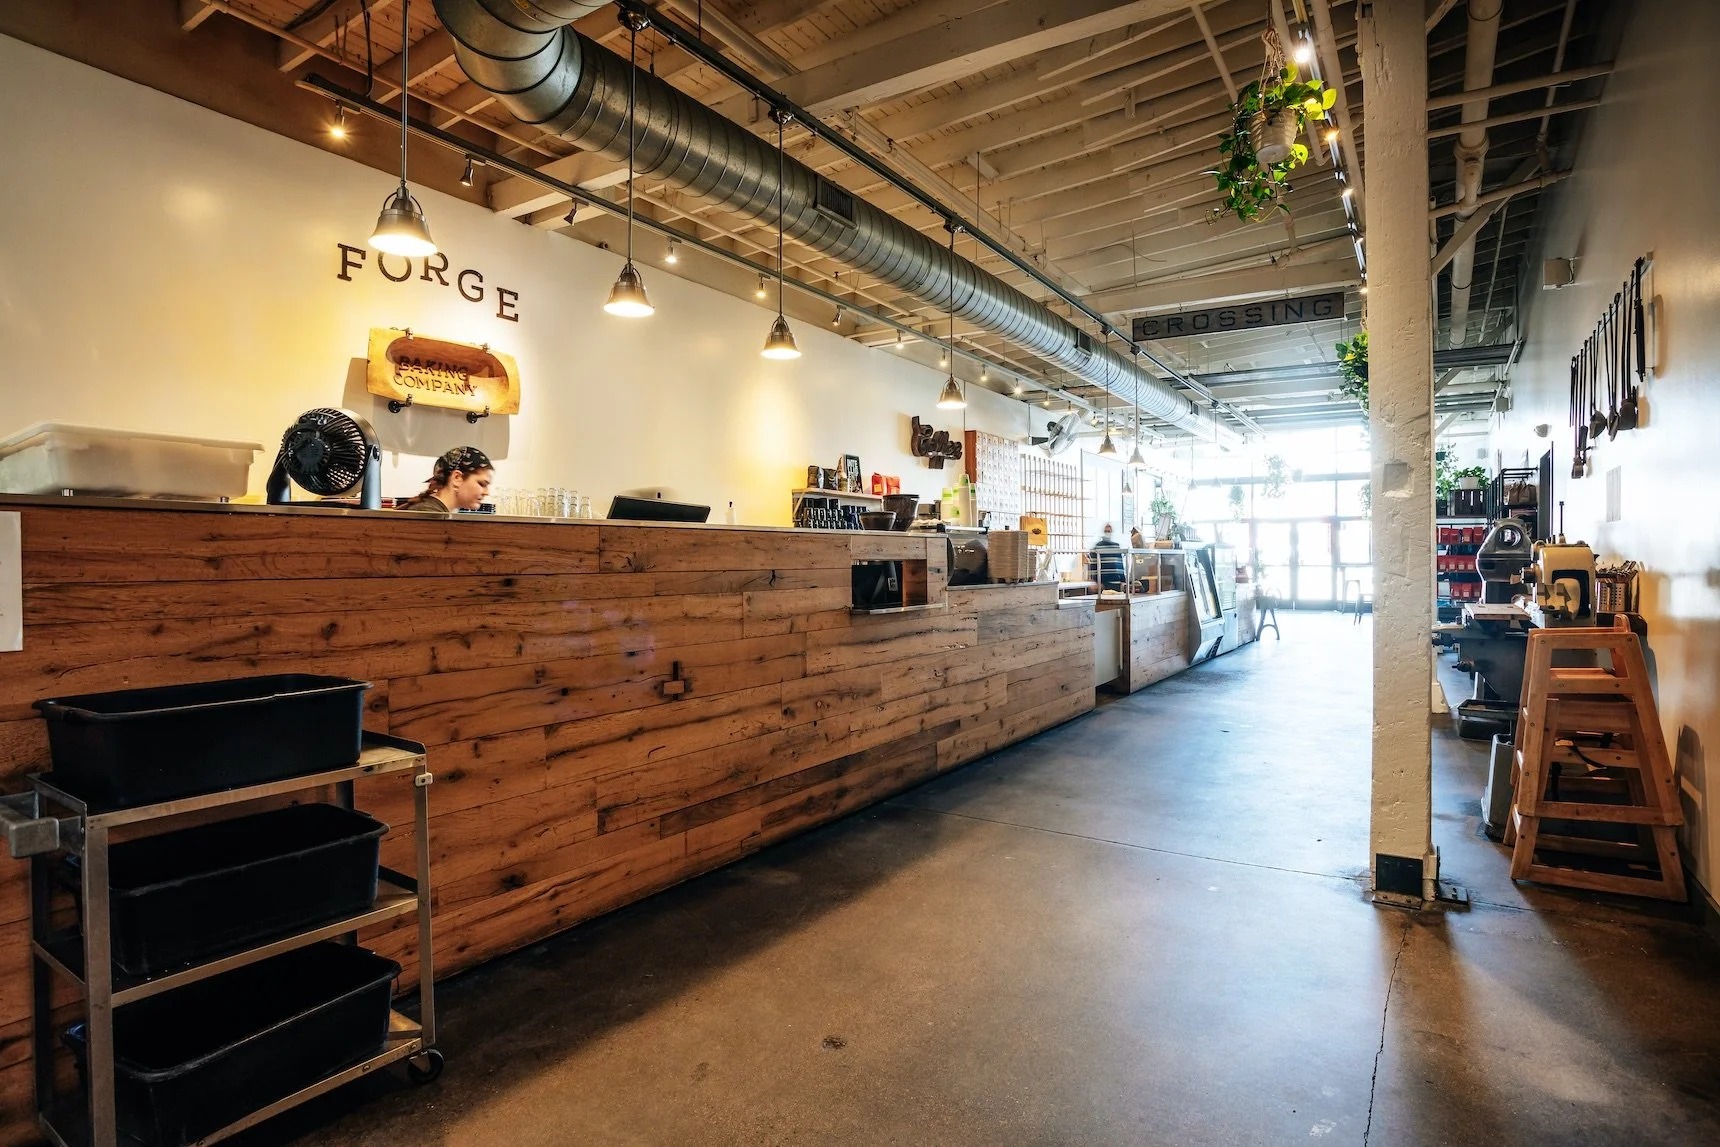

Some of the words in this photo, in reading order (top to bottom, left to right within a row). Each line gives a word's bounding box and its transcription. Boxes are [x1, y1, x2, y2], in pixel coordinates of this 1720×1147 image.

[337, 243, 519, 322] FORGE
[1142, 300, 1332, 336] CROSSING
[398, 355, 469, 382] BAKING
[393, 372, 478, 397] COMPANY
